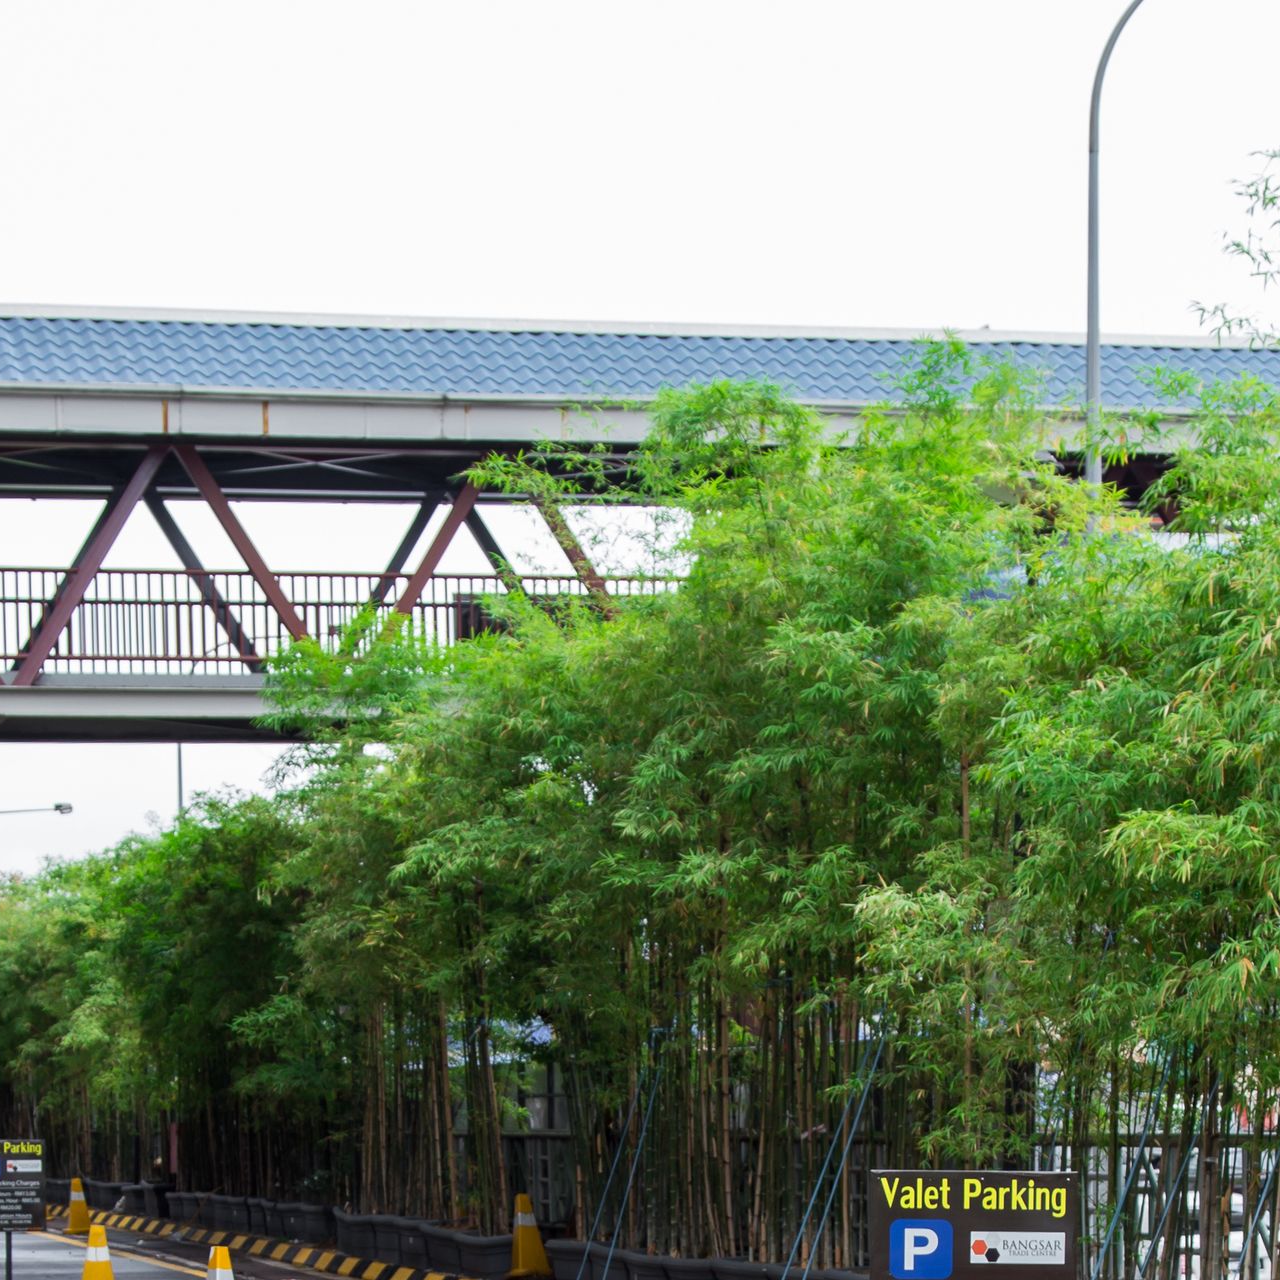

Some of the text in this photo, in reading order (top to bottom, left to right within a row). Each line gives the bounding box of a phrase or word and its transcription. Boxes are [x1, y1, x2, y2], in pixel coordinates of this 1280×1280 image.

[3, 1141, 42, 1156] Parking
[881, 1177, 1067, 1218] Valet Parking
[903, 1227, 939, 1271] P
[1002, 1239, 1062, 1251] BANGSAR
